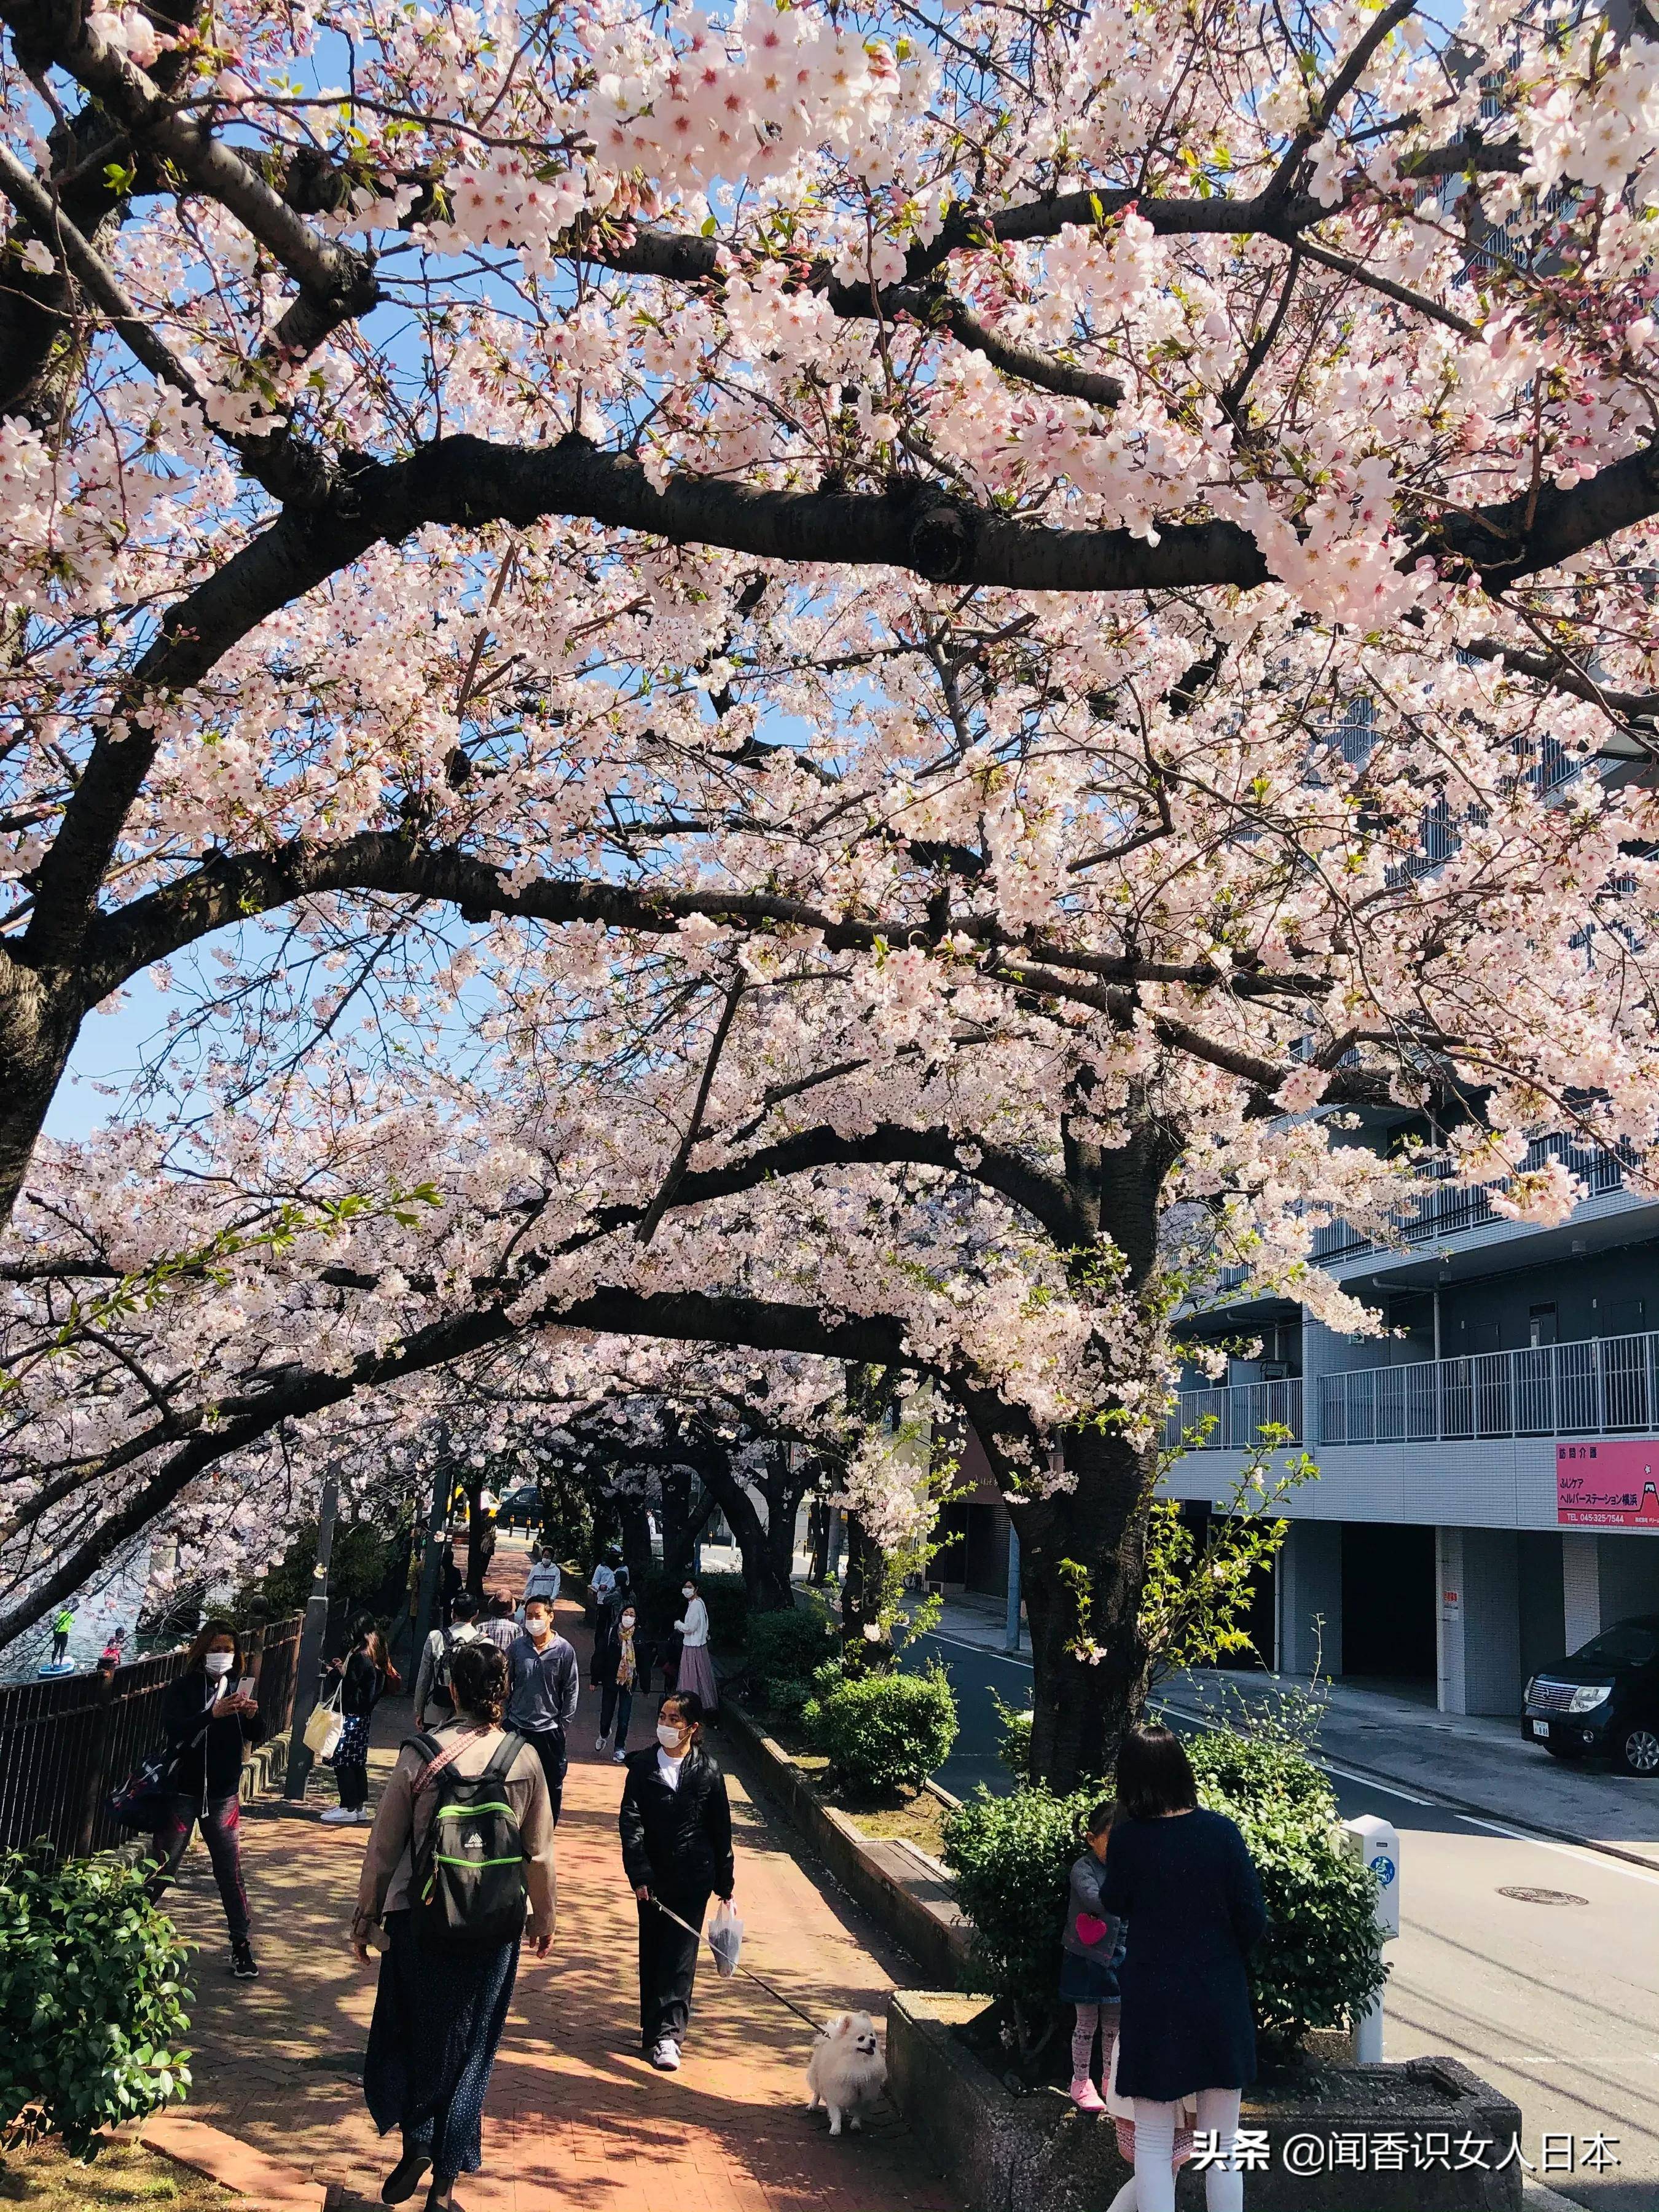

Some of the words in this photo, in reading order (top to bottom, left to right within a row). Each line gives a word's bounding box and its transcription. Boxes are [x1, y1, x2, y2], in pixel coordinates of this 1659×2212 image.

[1559, 1446, 1597, 1459] 訪問介護
[1560, 1478, 1583, 1489] ふじケア
[1560, 1493, 1637, 1506] ヘルパーステーション横浜
[1580, 1513, 1624, 1523] 045-325-7544
